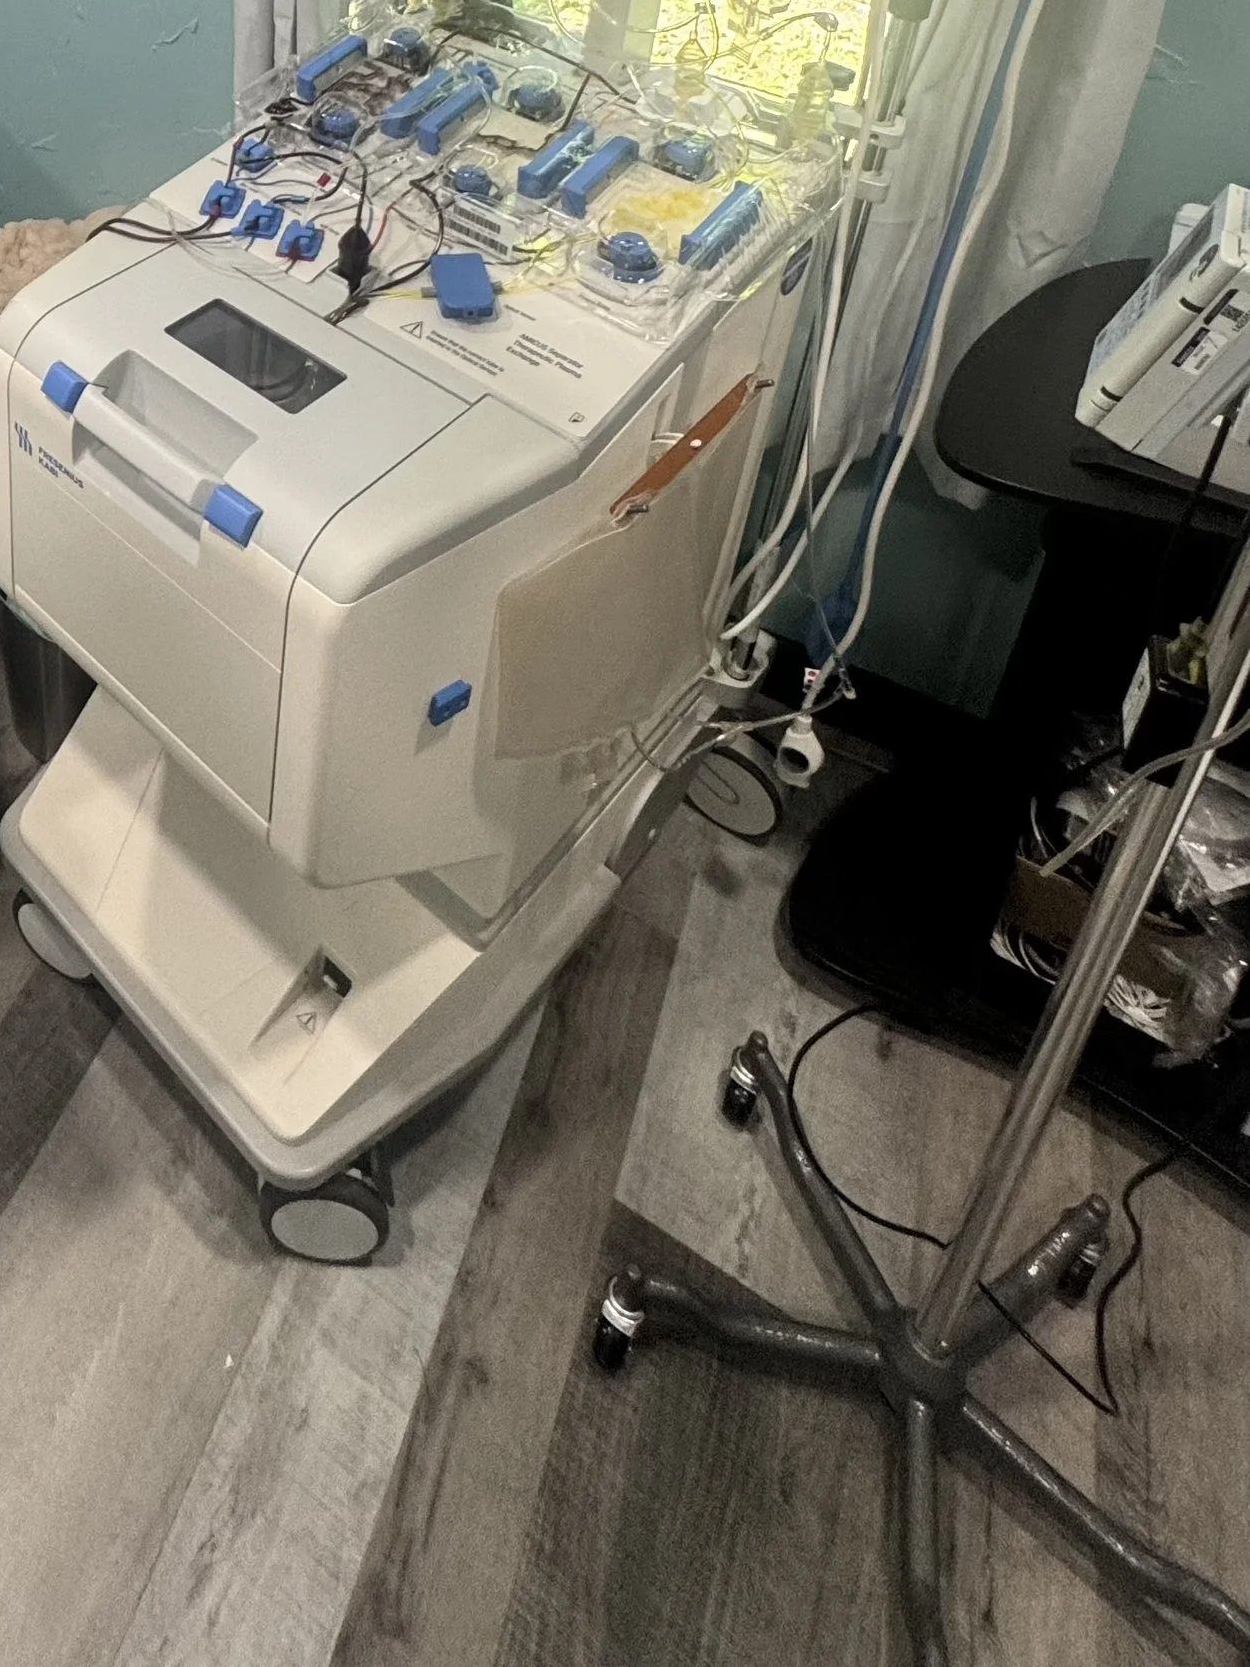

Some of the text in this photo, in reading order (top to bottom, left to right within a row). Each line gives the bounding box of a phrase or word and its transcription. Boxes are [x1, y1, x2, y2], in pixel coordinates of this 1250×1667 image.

[506, 345, 540, 367] Exchange
[513, 339, 582, 379] Therapeutic Plasma
[547, 347, 584, 369] Separator
